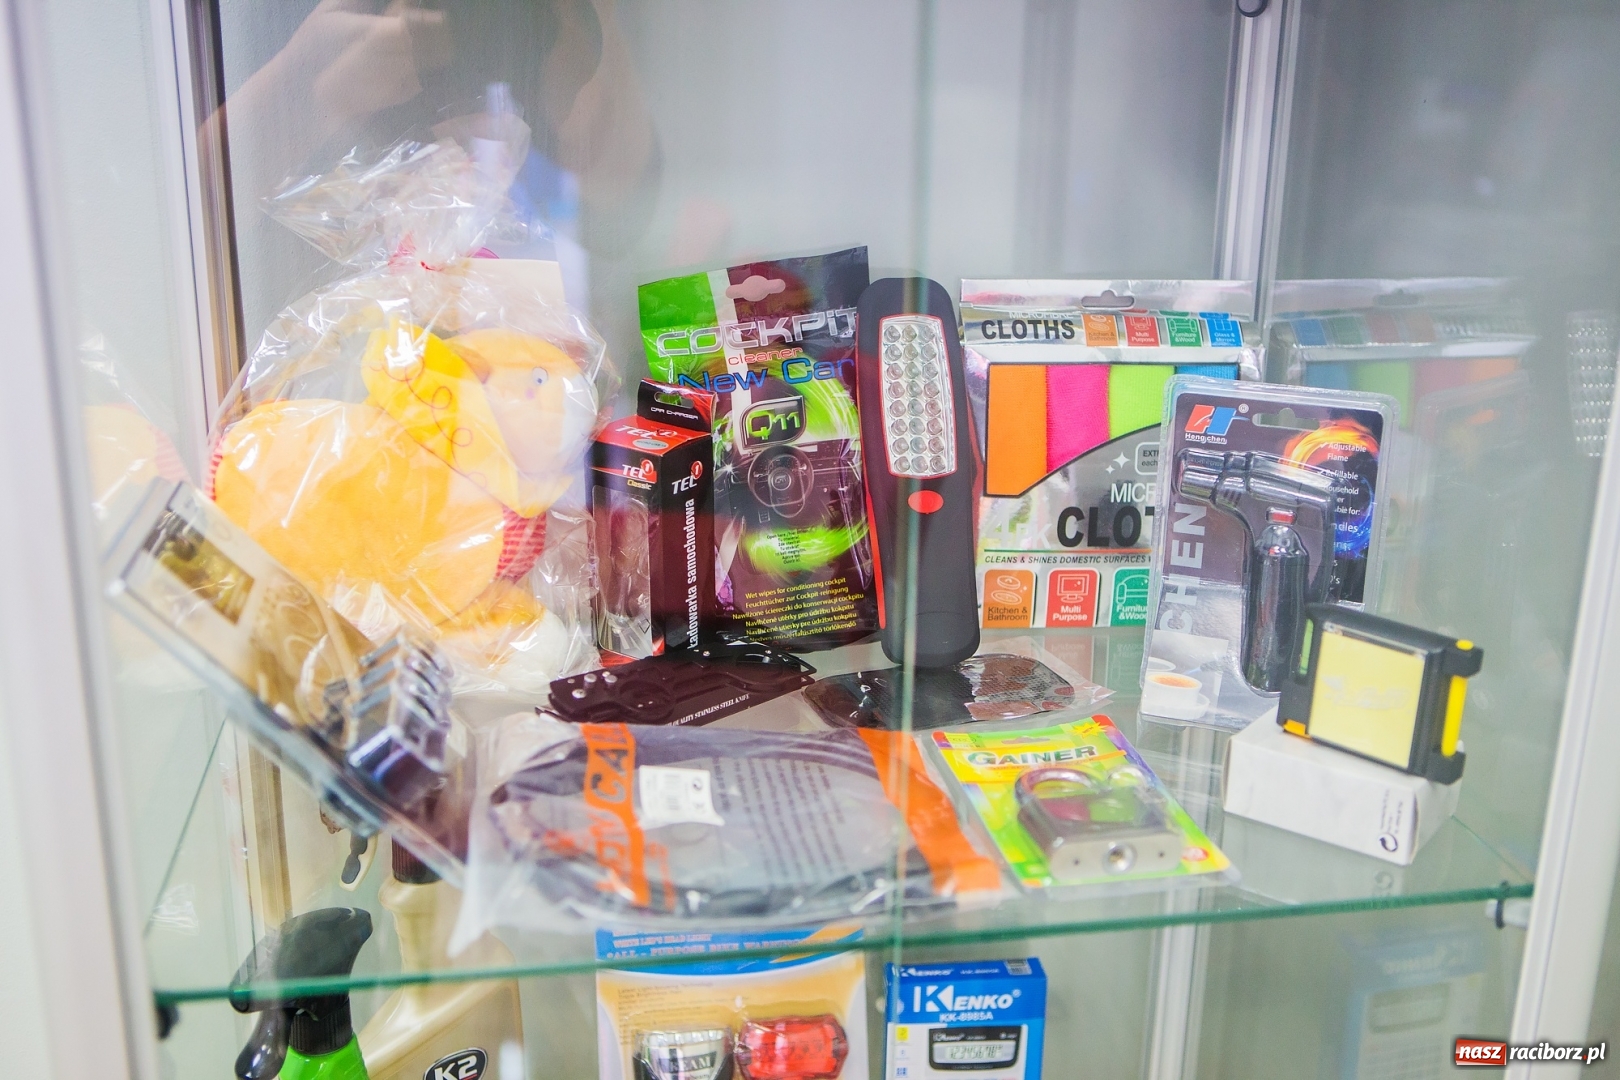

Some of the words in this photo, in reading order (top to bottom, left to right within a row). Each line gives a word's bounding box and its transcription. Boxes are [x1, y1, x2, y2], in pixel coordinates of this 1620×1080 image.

[656, 307, 858, 357] COCKPIT
[981, 318, 1075, 340] CLOTHS
[728, 347, 802, 366] cleaner
[678, 368, 768, 394] New
[782, 357, 855, 384] Car
[650, 406, 665, 415] CAR
[666, 409, 699, 420] CHARGER
[746, 408, 801, 440] Q11
[1328, 442, 1367, 452] Adjustable
[1327, 453, 1349, 462] Flame
[627, 479, 653, 491] Classic
[1325, 485, 1359, 495] ousehold
[683, 499, 698, 584] samochodowa
[985, 556, 1018, 564] CLEANS
[1020, 556, 1026, 564] &
[1028, 556, 1057, 564] SHINES
[1060, 555, 1101, 564] DOMESTIC
[1103, 555, 1146, 564] SURFACES
[745, 592, 758, 600] Wet
[758, 589, 776, 598] wipes
[777, 587, 785, 595] for
[786, 581, 824, 592] conditioning
[824, 577, 846, 586] cockpit
[803, 597, 837, 608] konserwacji
[838, 593, 864, 602] cockpitu
[797, 612, 809, 620] pro
[831, 604, 855, 613] kokpitu
[988, 606, 1019, 614] Kitchen
[1021, 606, 1028, 614] &
[1061, 605, 1081, 613] Multi
[1116, 604, 1147, 613] Furnitu
[987, 613, 1028, 621] Bathroom
[1053, 613, 1088, 622] Purpose
[1119, 612, 1147, 620] &Woo
[800, 620, 811, 628] pre
[694, 704, 720, 719] STAINLESS
[719, 699, 734, 710] STEEL
[967, 745, 1097, 766] GAINER
[913, 985, 1014, 1013] KENKO
[434, 1055, 478, 1080] K2
